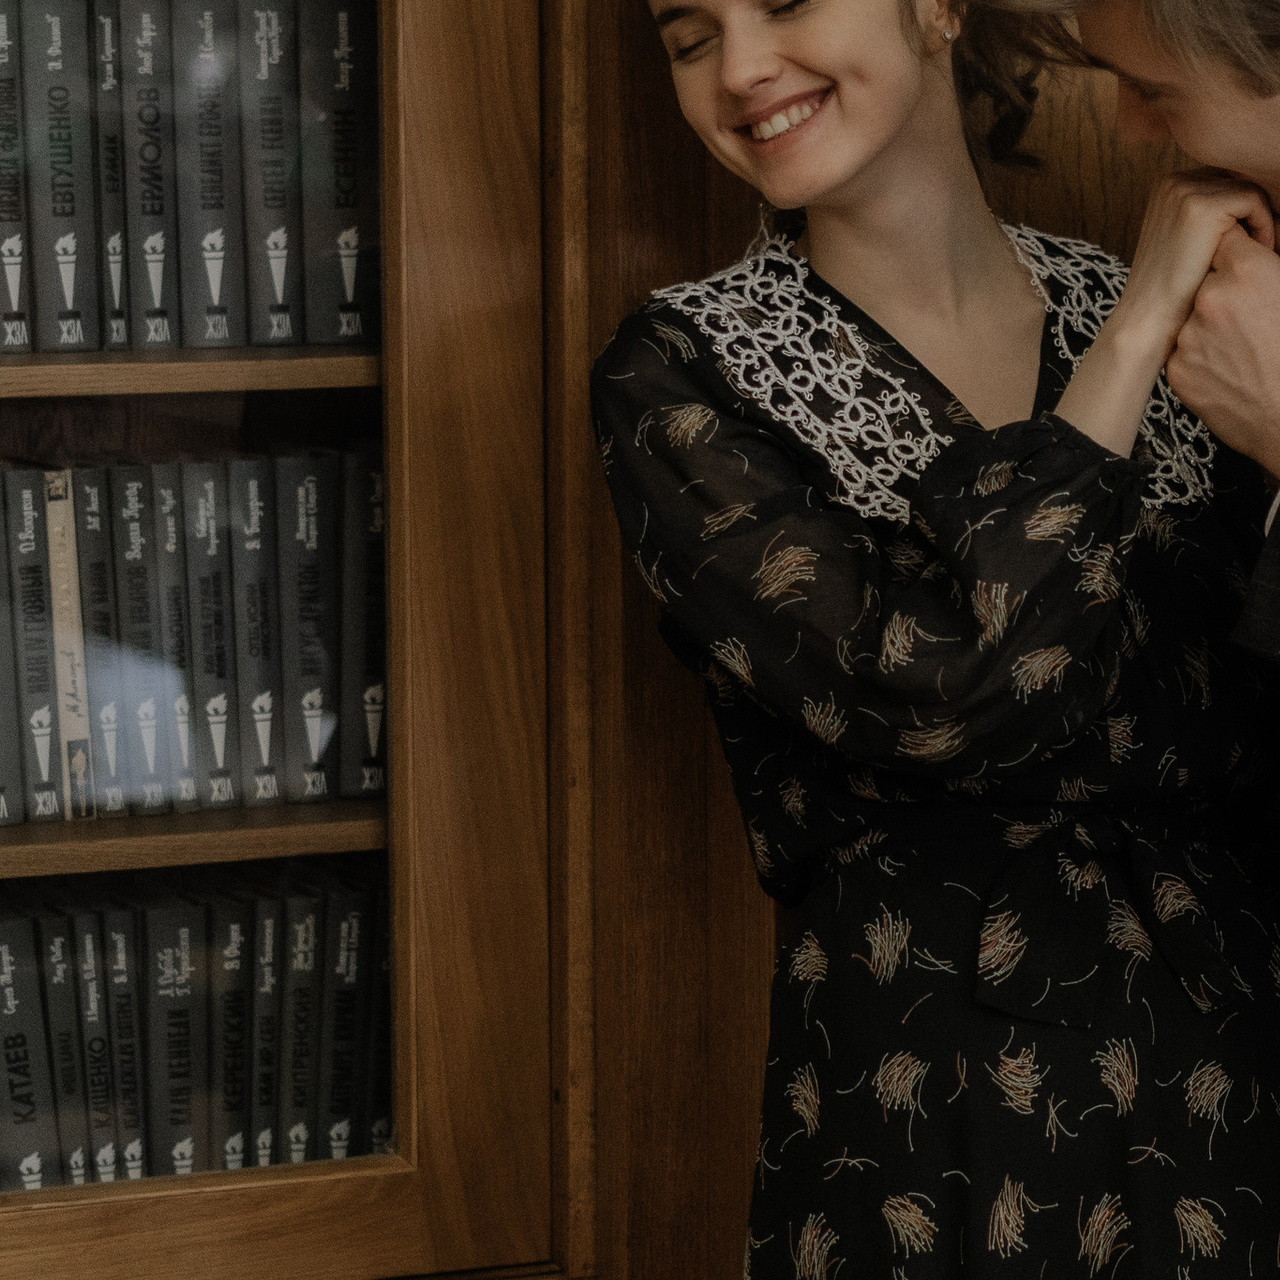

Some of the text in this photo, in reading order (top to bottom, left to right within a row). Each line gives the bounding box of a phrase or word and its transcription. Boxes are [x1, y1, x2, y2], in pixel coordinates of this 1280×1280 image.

[259, 95, 285, 151] ЕСЕНИН
[47, 85, 76, 218] ЕВТУШЕНКО
[103, 134, 121, 193] ЕРМАК
[137, 87, 164, 217] ЕРМОЛОВ
[333, 108, 359, 210] ЕСЕНИН
[258, 157, 287, 210] СЕРГЕЙ
[4, 321, 28, 345] ЖЗЛ
[59, 320, 84, 344] ЖЗЛ
[147, 318, 170, 342] ЖЗЛ
[205, 315, 229, 339] ЖЗЛ
[270, 314, 292, 338] ЖЗЛ
[340, 312, 362, 336] ЖЗЛ
[18, 564, 47, 633] ГРОЗНЫЙ
[24, 656, 51, 694] ИВАН
[35, 791, 59, 815] ЖЗЛ
[210, 778, 234, 802] ЖЗЛ
[255, 775, 279, 799] ЖЗЛ
[304, 772, 328, 796] ЖЗЛ
[220, 989, 246, 1113] КЕРЕНСКИЙ
[291, 987, 312, 1110] КИПРЕНСКИЙ
[3, 1032, 38, 1125] КАТАЕВ
[87, 1036, 113, 1130] КАЩЕНКО
